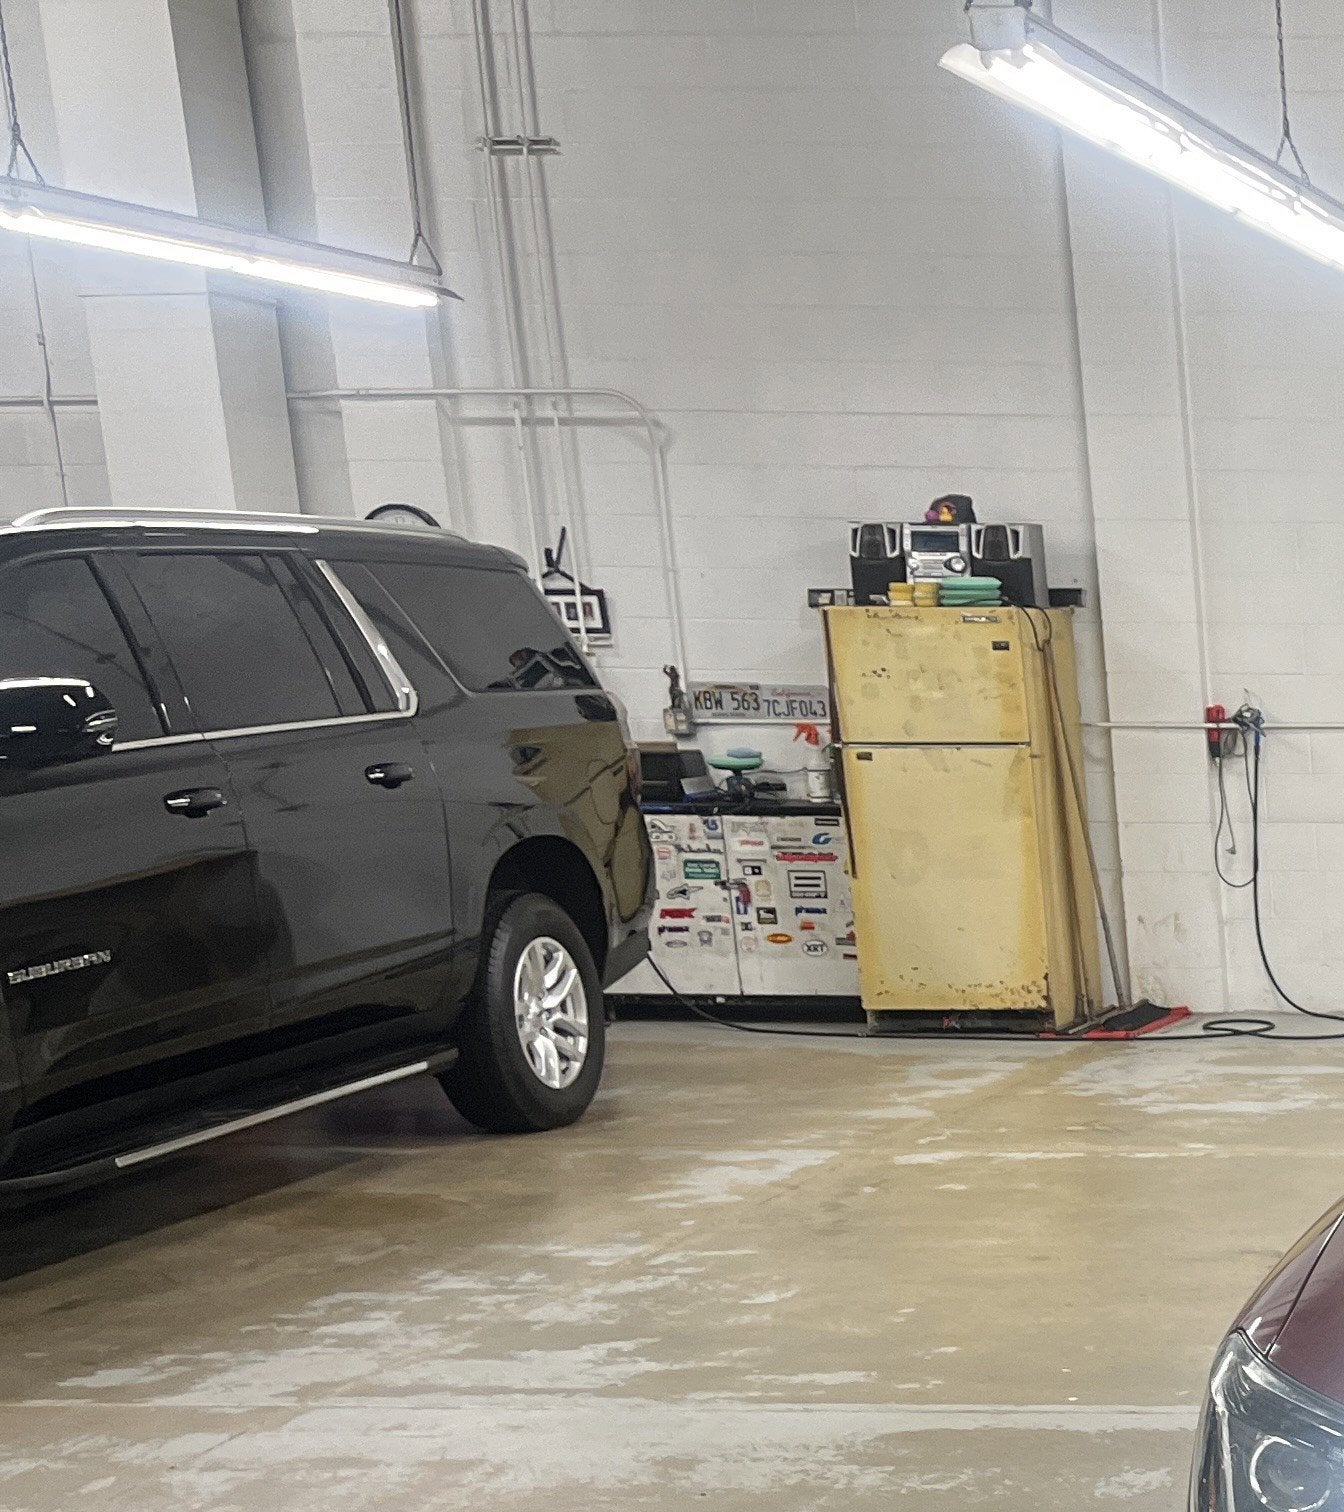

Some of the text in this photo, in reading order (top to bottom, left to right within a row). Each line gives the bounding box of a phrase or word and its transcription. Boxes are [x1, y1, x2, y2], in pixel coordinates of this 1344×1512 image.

[693, 690, 760, 711] KBW 563
[762, 699, 827, 717] 7CJF043
